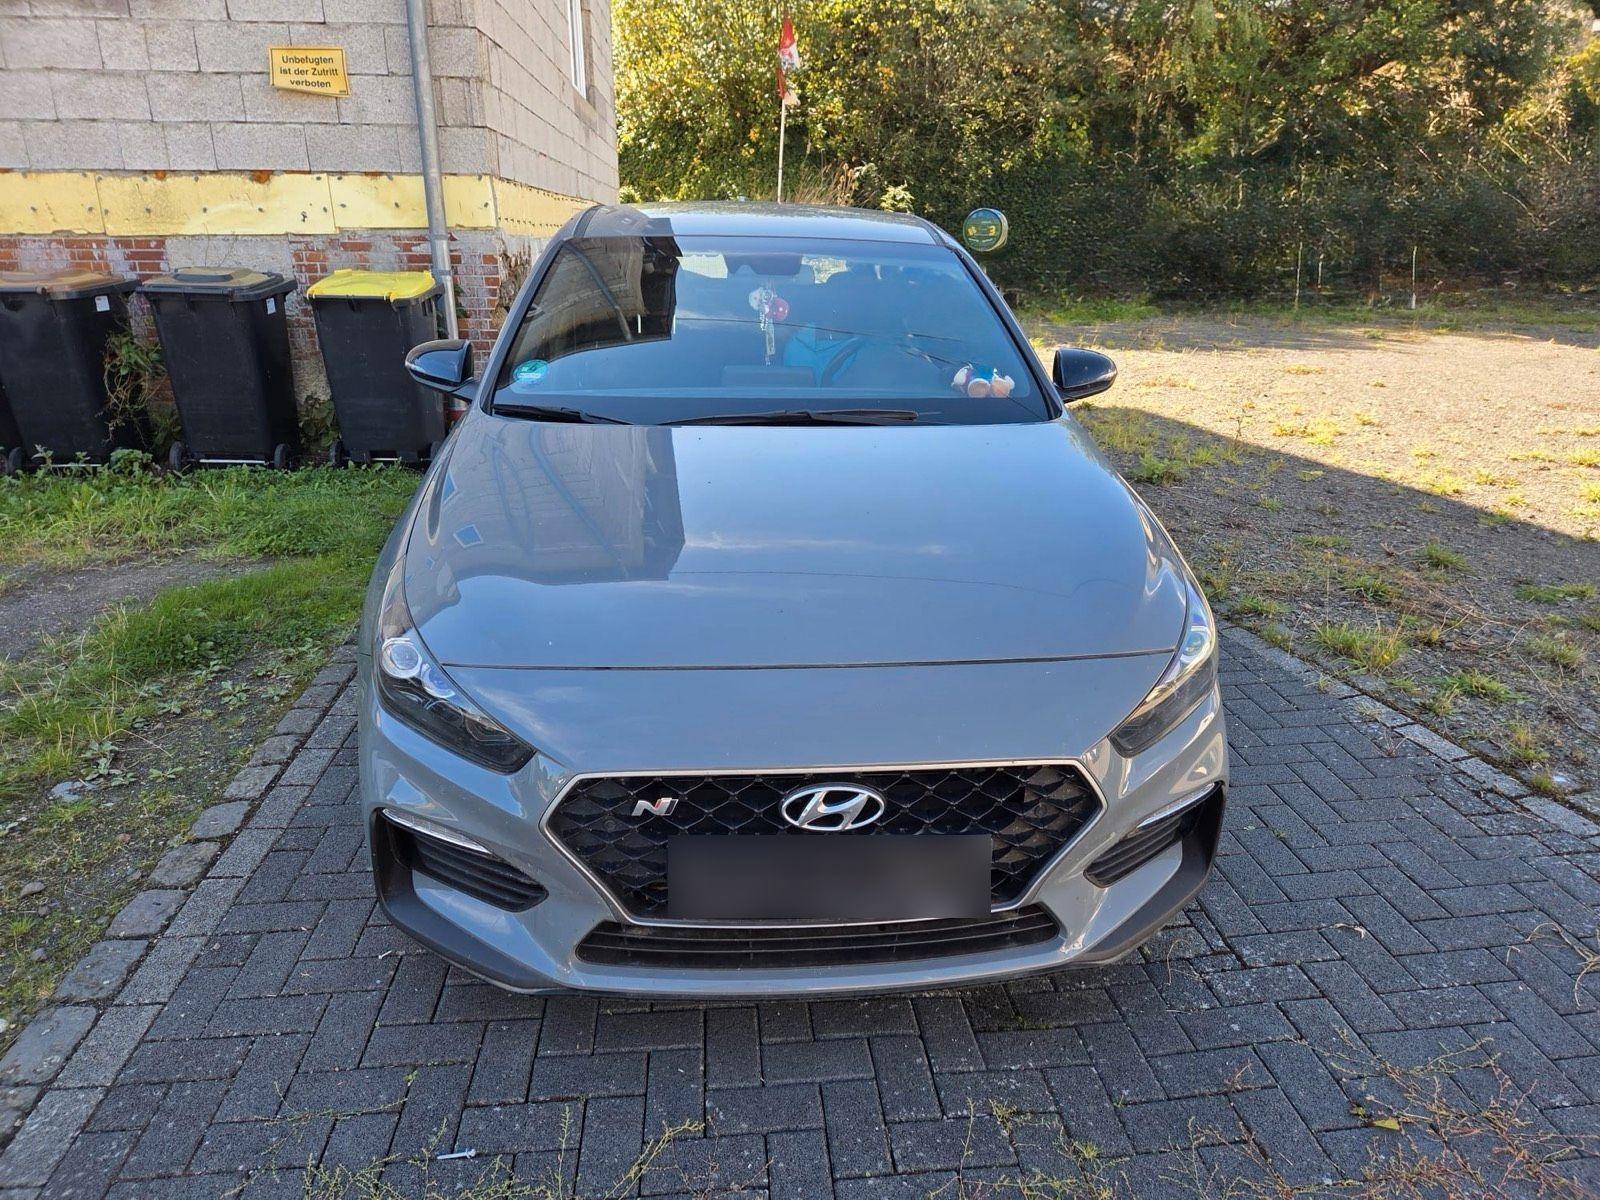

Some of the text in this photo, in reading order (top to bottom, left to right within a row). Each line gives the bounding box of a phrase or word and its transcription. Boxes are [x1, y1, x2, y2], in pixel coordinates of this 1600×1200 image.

[281, 55, 334, 65] Unbefugten
[293, 67, 309, 76] der
[311, 68, 339, 77] Zutritt
[289, 79, 331, 88] verboten
